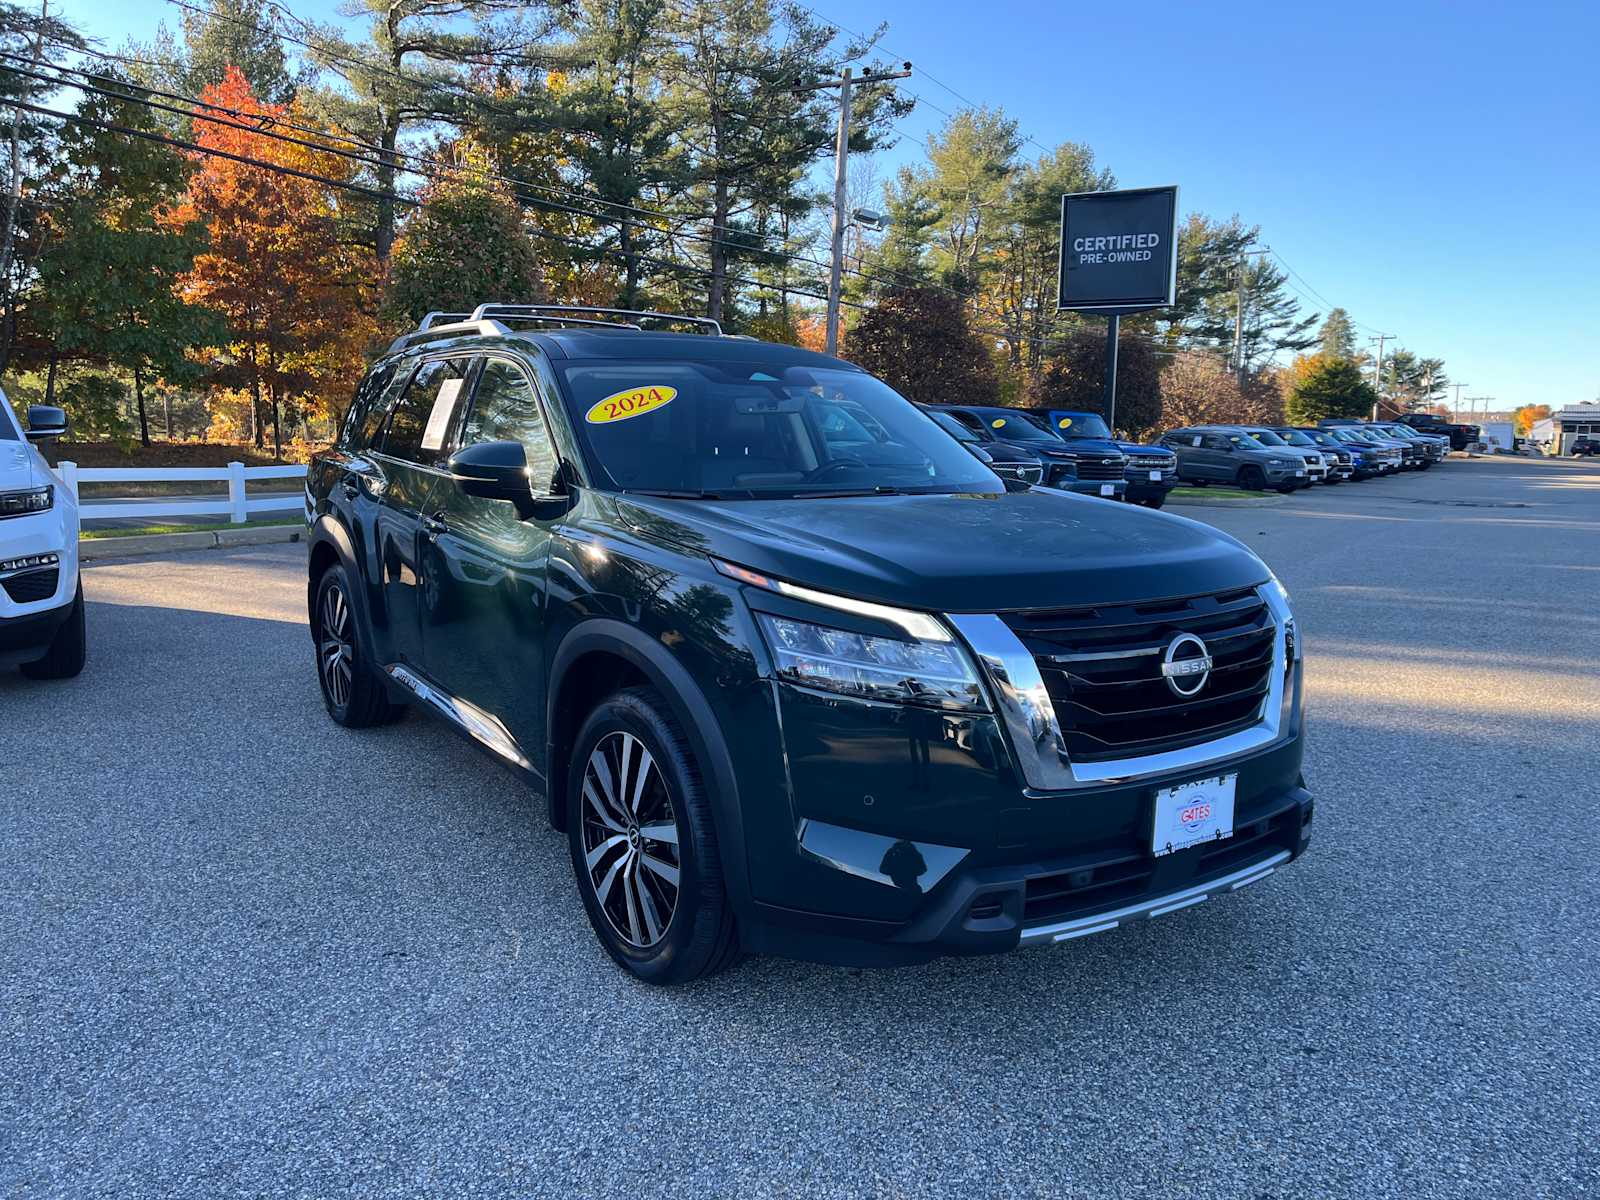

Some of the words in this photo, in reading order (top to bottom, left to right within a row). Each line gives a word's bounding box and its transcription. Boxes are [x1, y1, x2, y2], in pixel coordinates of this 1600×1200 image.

[1074, 233, 1159, 251] CERTIFIED
[1080, 250, 1151, 264] PRE-OWNED
[604, 388, 663, 418] 2024
[1181, 804, 1210, 823] GATES
